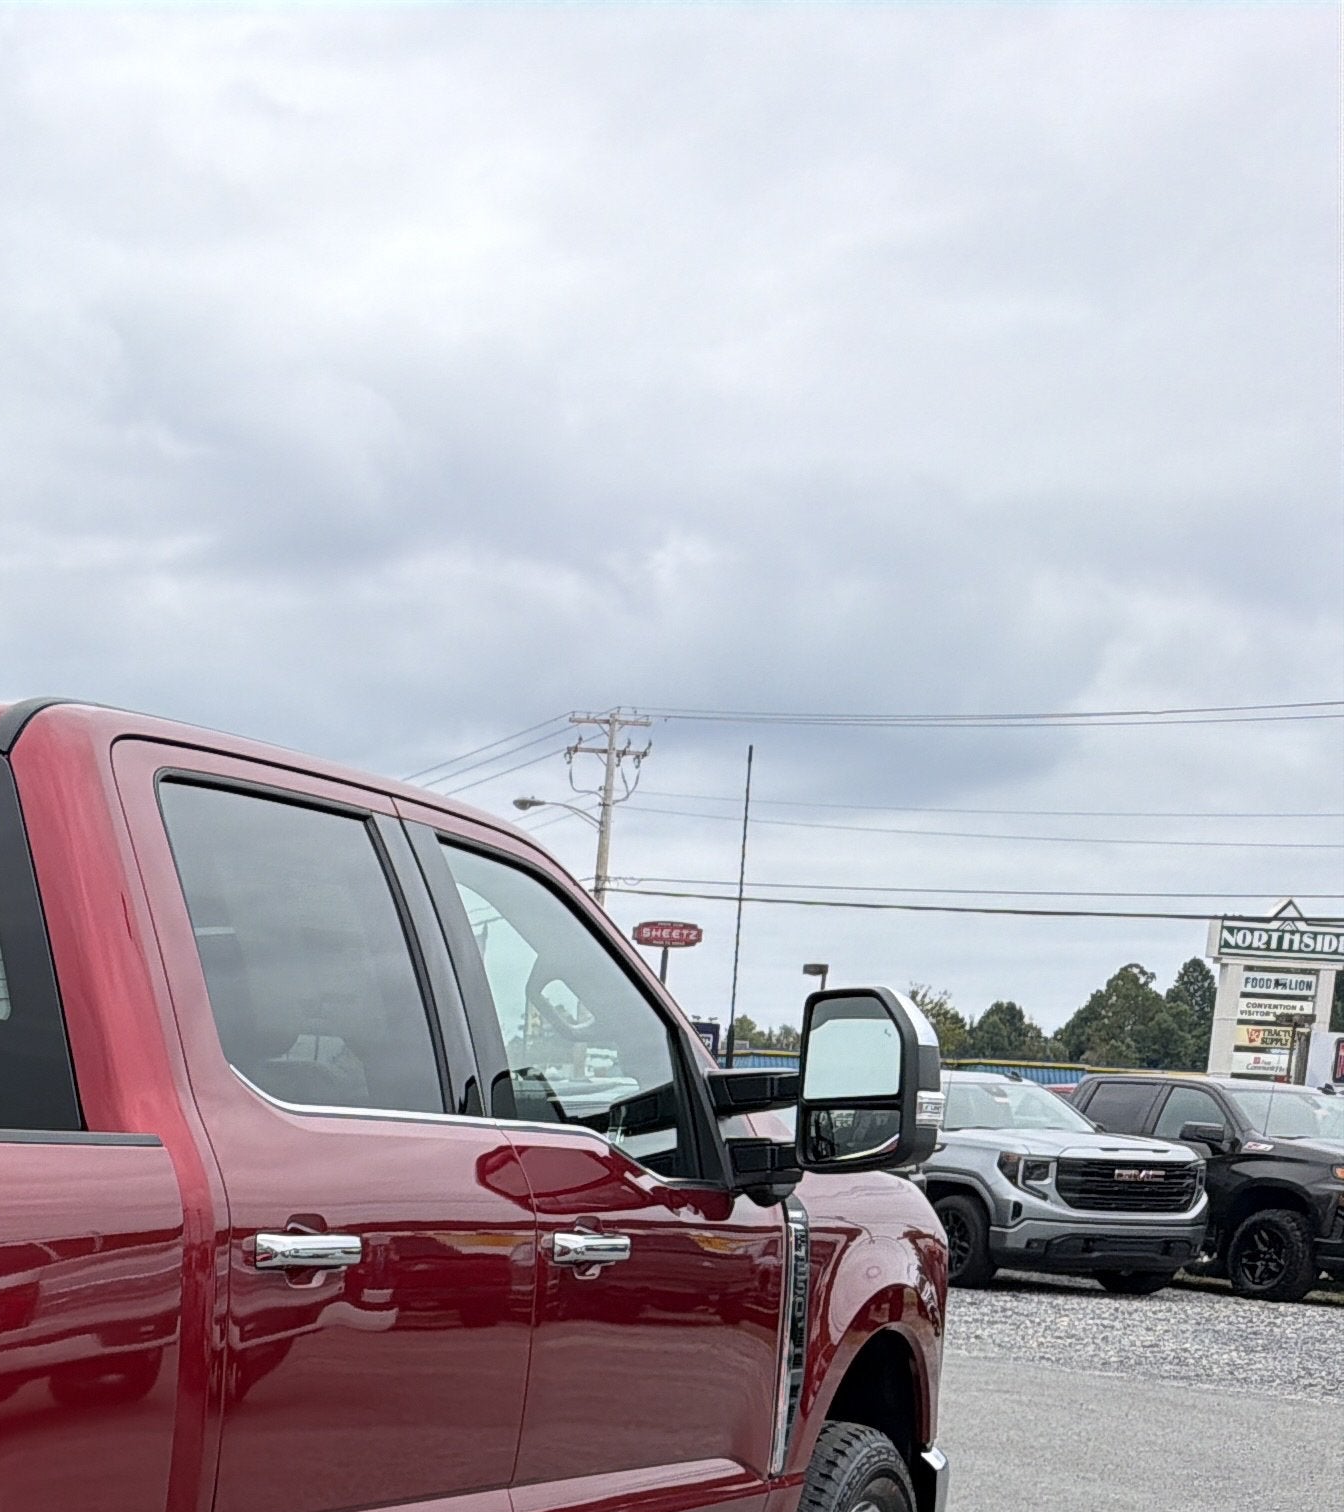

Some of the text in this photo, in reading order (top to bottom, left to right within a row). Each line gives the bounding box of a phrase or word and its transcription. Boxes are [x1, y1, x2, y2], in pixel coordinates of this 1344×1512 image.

[642, 927, 698, 940] SHEETZ
[1244, 976, 1313, 992] FOOD LION
[1245, 1001, 1297, 1011] CONVENTION
